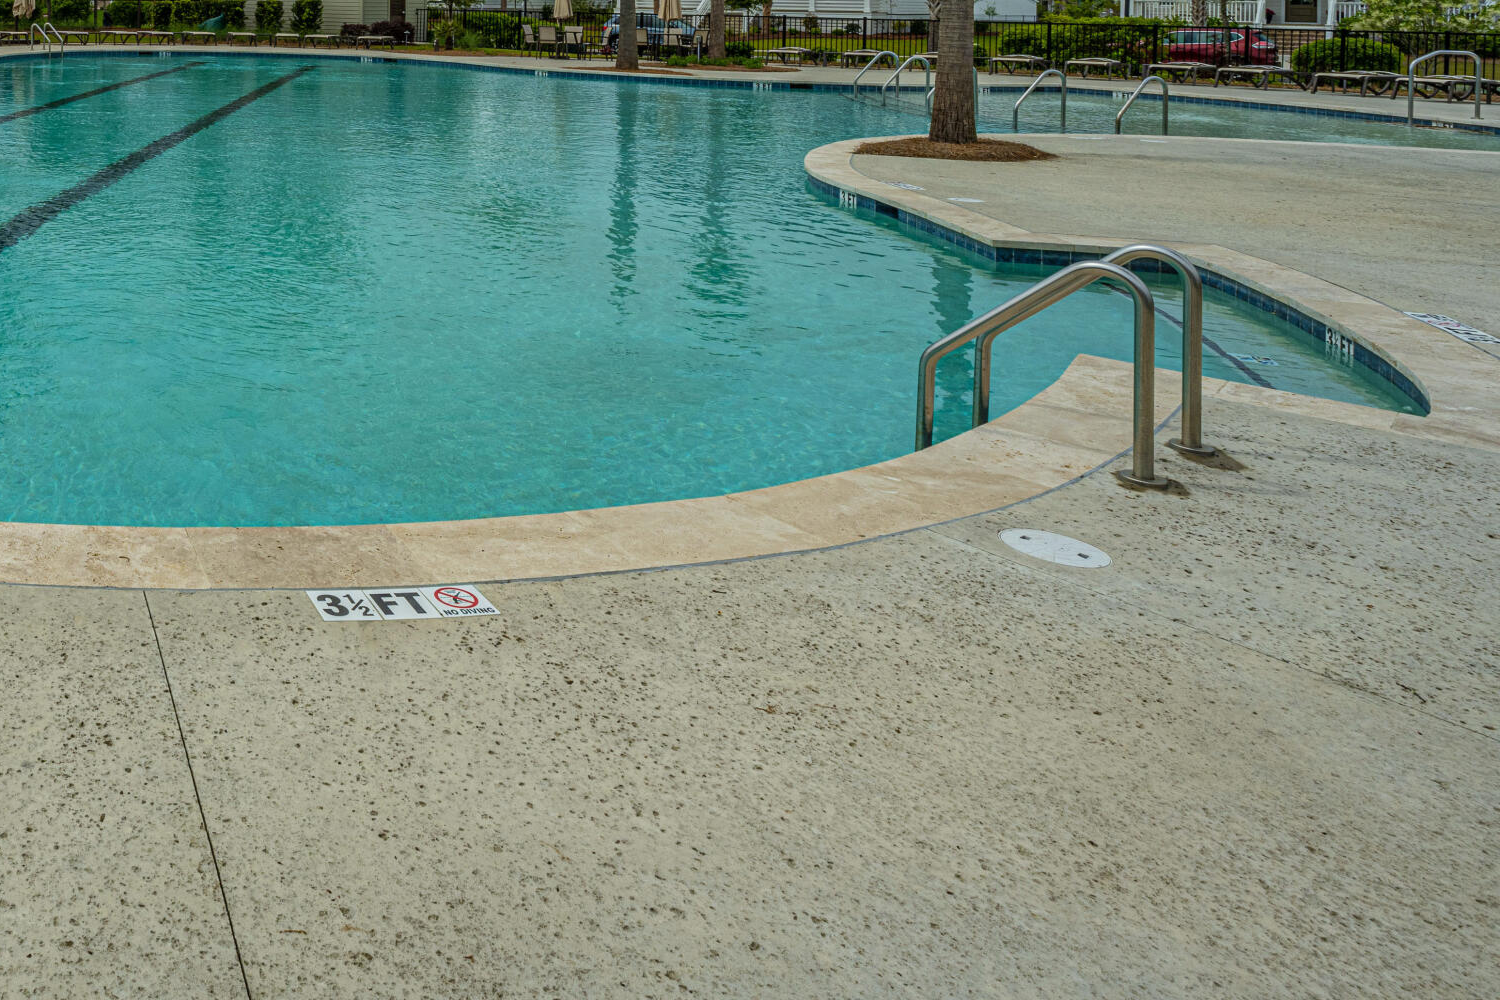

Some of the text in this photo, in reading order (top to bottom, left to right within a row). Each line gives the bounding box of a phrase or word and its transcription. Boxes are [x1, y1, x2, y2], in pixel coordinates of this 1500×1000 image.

[847, 192, 856, 205] FT
[1340, 334, 1353, 354] FT
[369, 591, 428, 616] FT
[459, 607, 496, 615] DIVING
